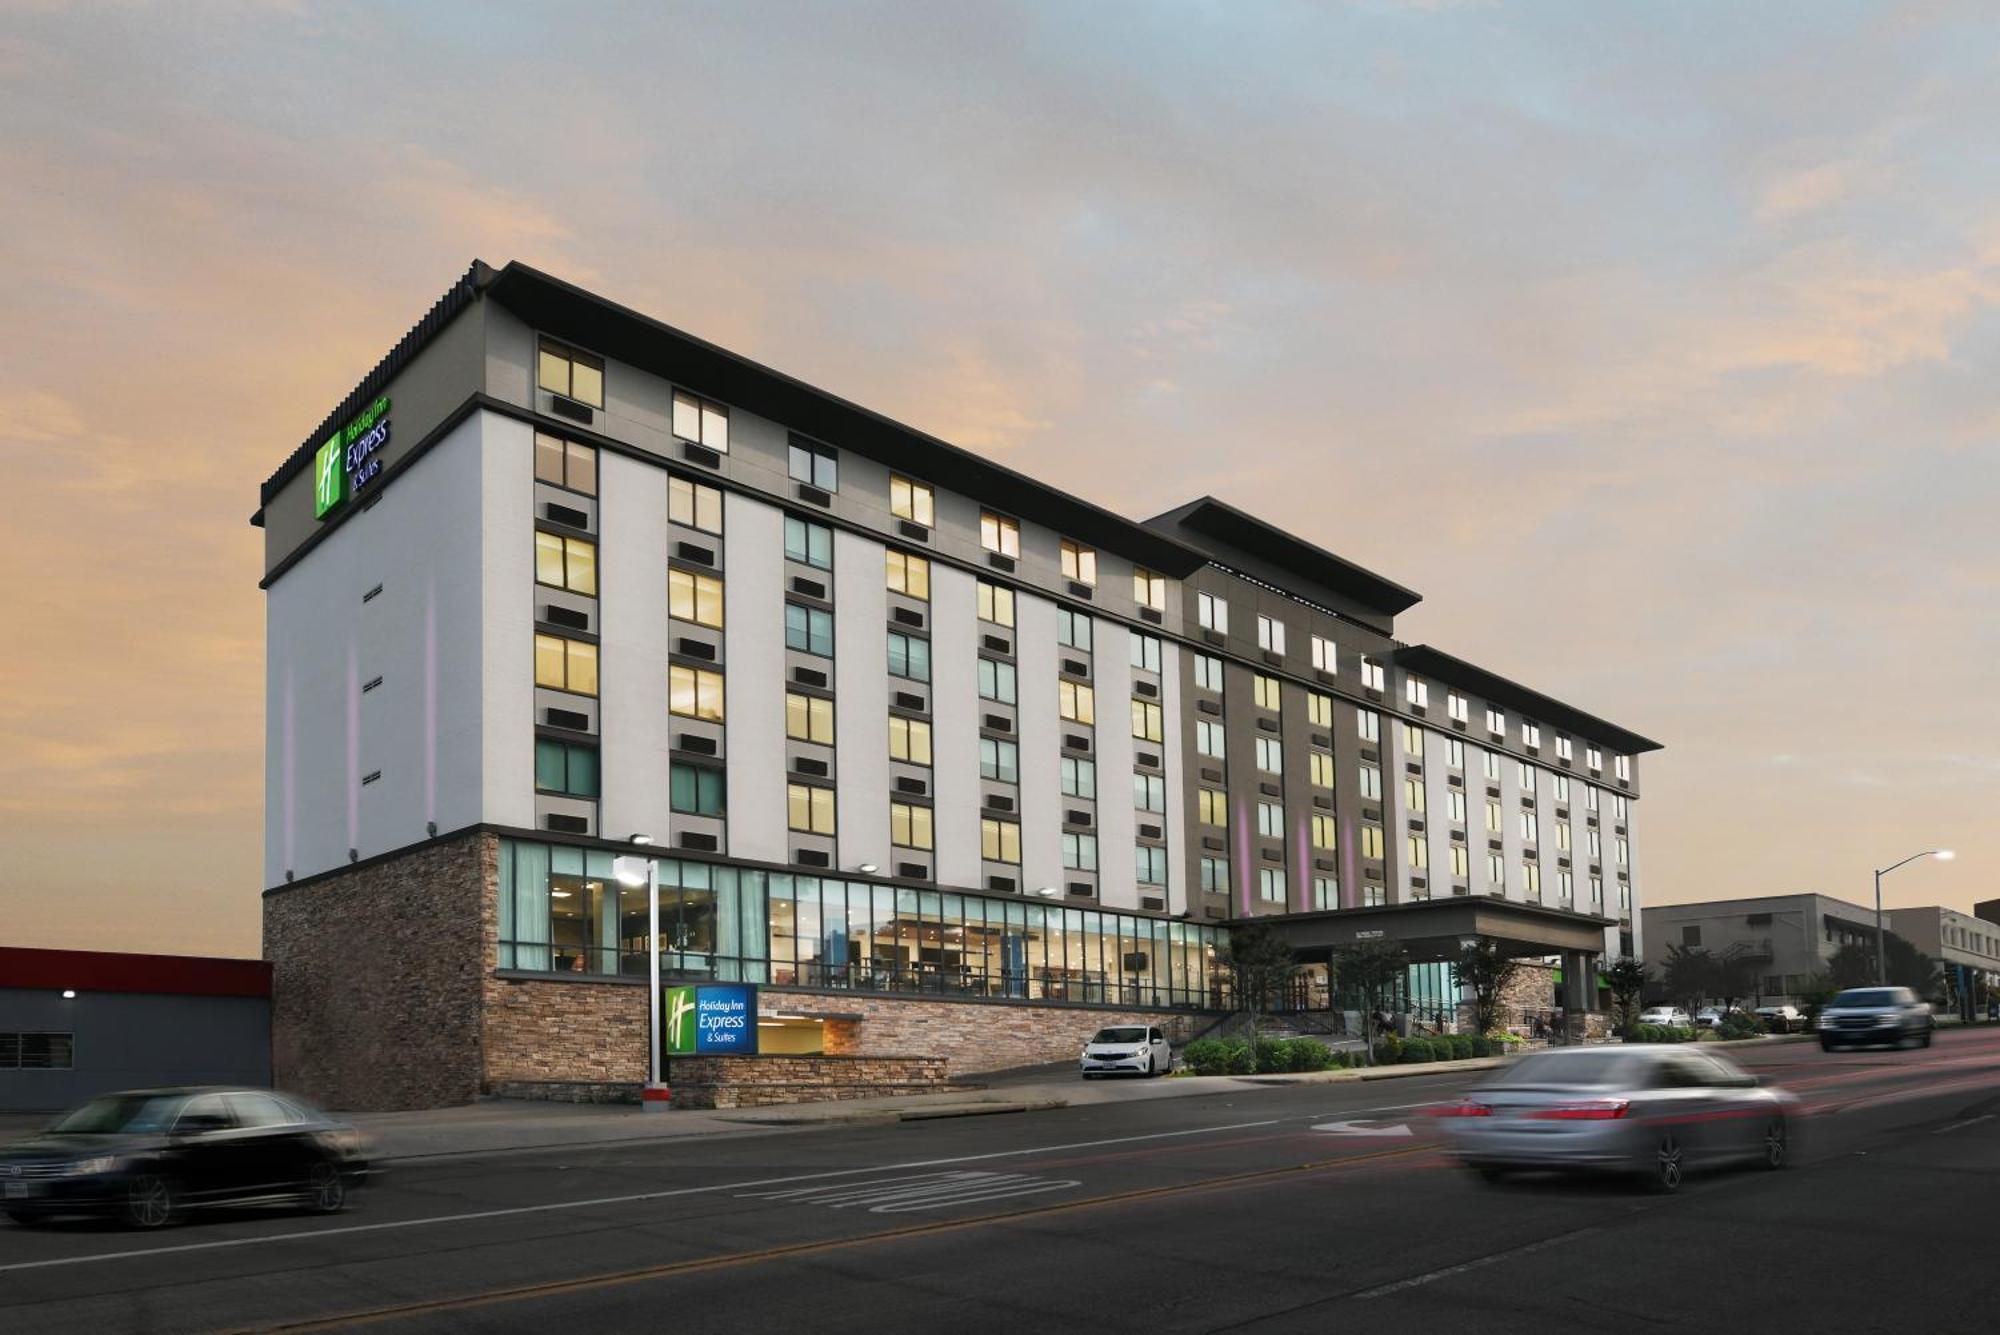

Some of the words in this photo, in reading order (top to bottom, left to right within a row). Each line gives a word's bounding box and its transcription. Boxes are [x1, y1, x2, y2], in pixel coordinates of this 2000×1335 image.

[346, 407, 374, 444] Holiday
[346, 419, 386, 472] Express
[699, 1000, 730, 1013] Holiday
[730, 999, 744, 1010] Inn
[699, 1013, 744, 1032] Express
[706, 1032, 713, 1042] &
[714, 1032, 736, 1042] Suites
